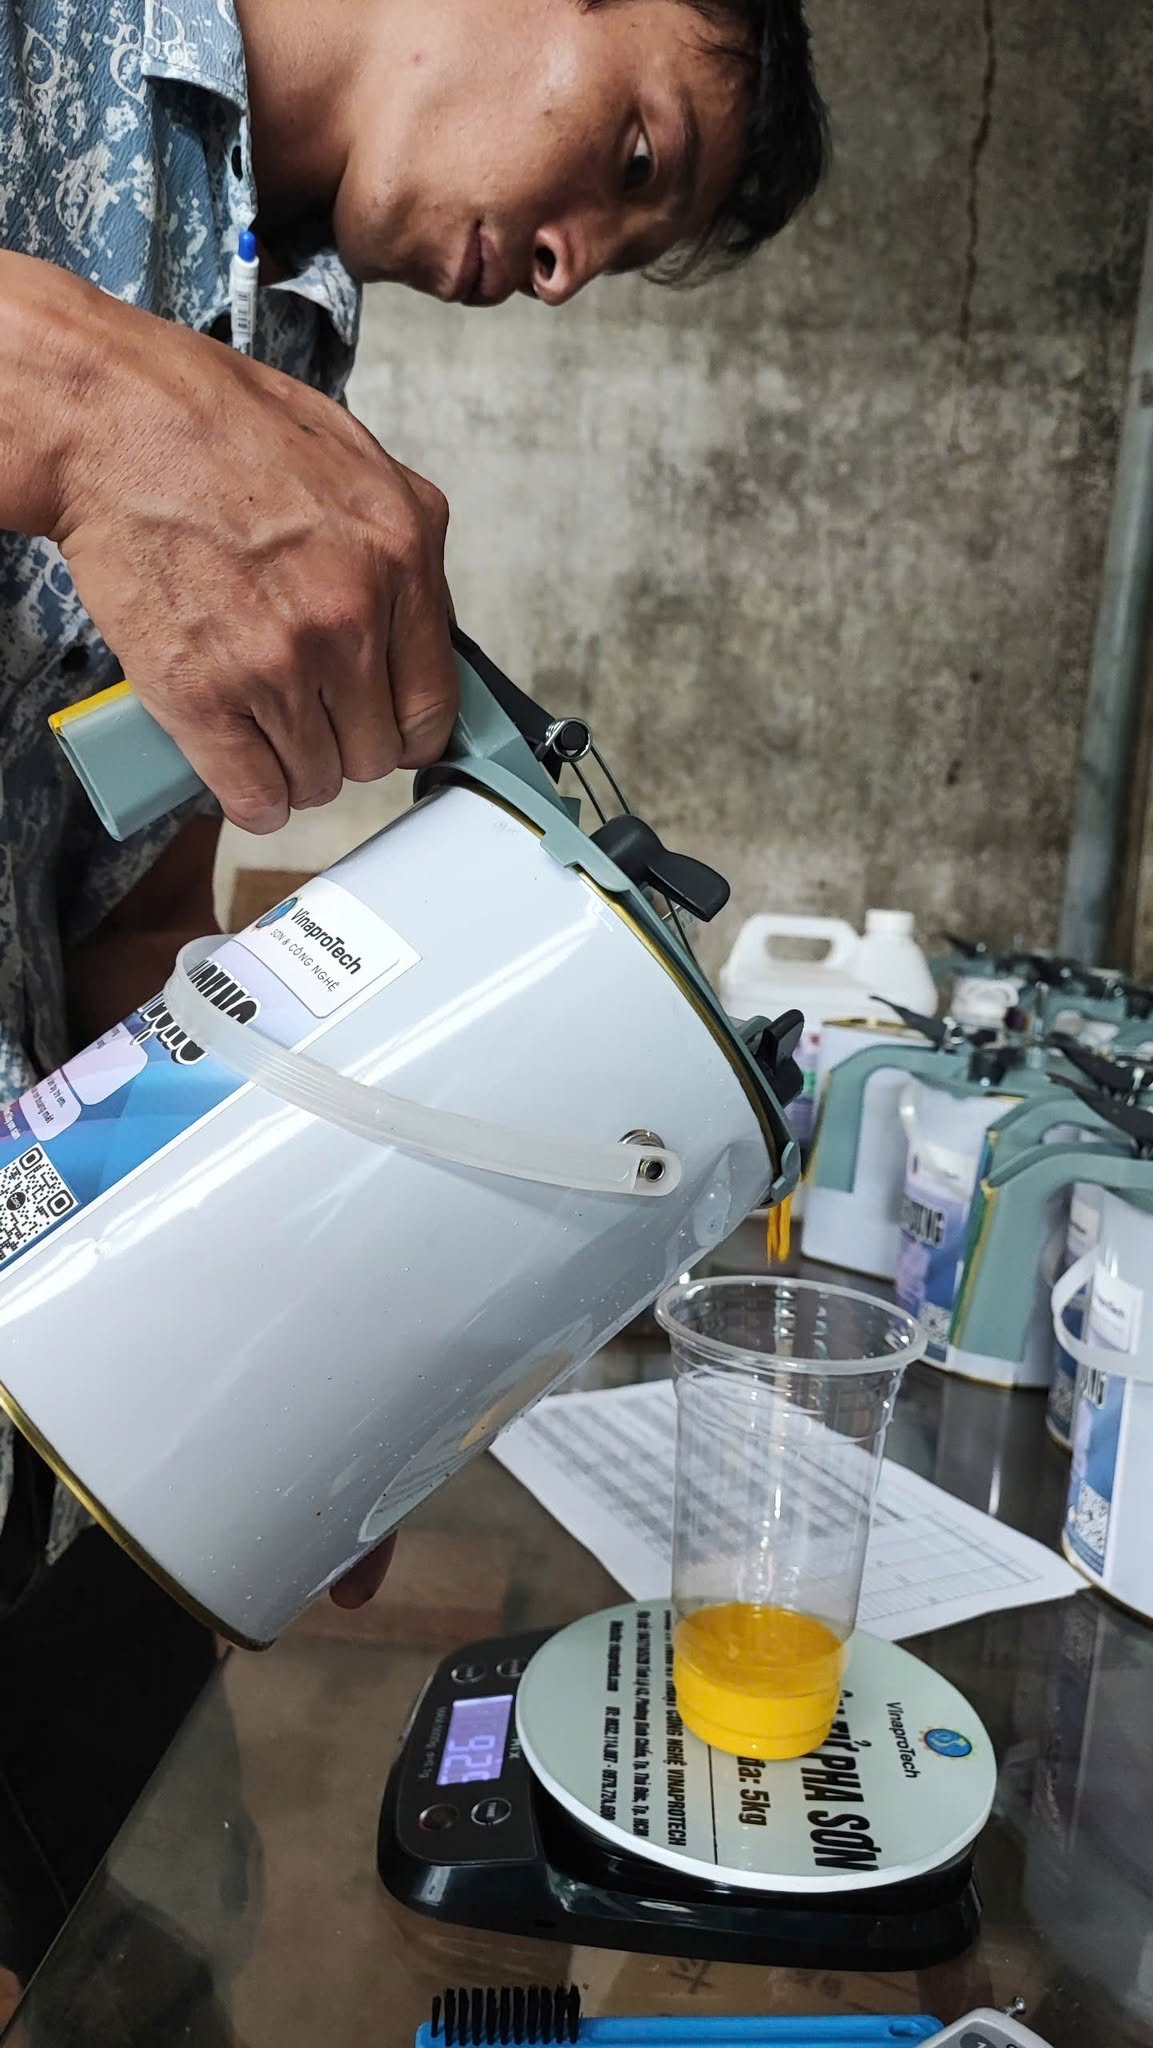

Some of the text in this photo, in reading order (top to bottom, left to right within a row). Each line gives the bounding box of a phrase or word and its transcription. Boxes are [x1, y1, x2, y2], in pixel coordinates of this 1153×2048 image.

[288, 943, 314, 967] CÔNG
[290, 907, 362, 975] VinaproTech
[886, 1701, 921, 1779] VinaproTech
[667, 1769, 687, 1847] VINAPROTECH
[739, 1789, 771, 1826] 5kg
[800, 1752, 865, 1802] PHA
[807, 1810, 882, 1872] SƠN
